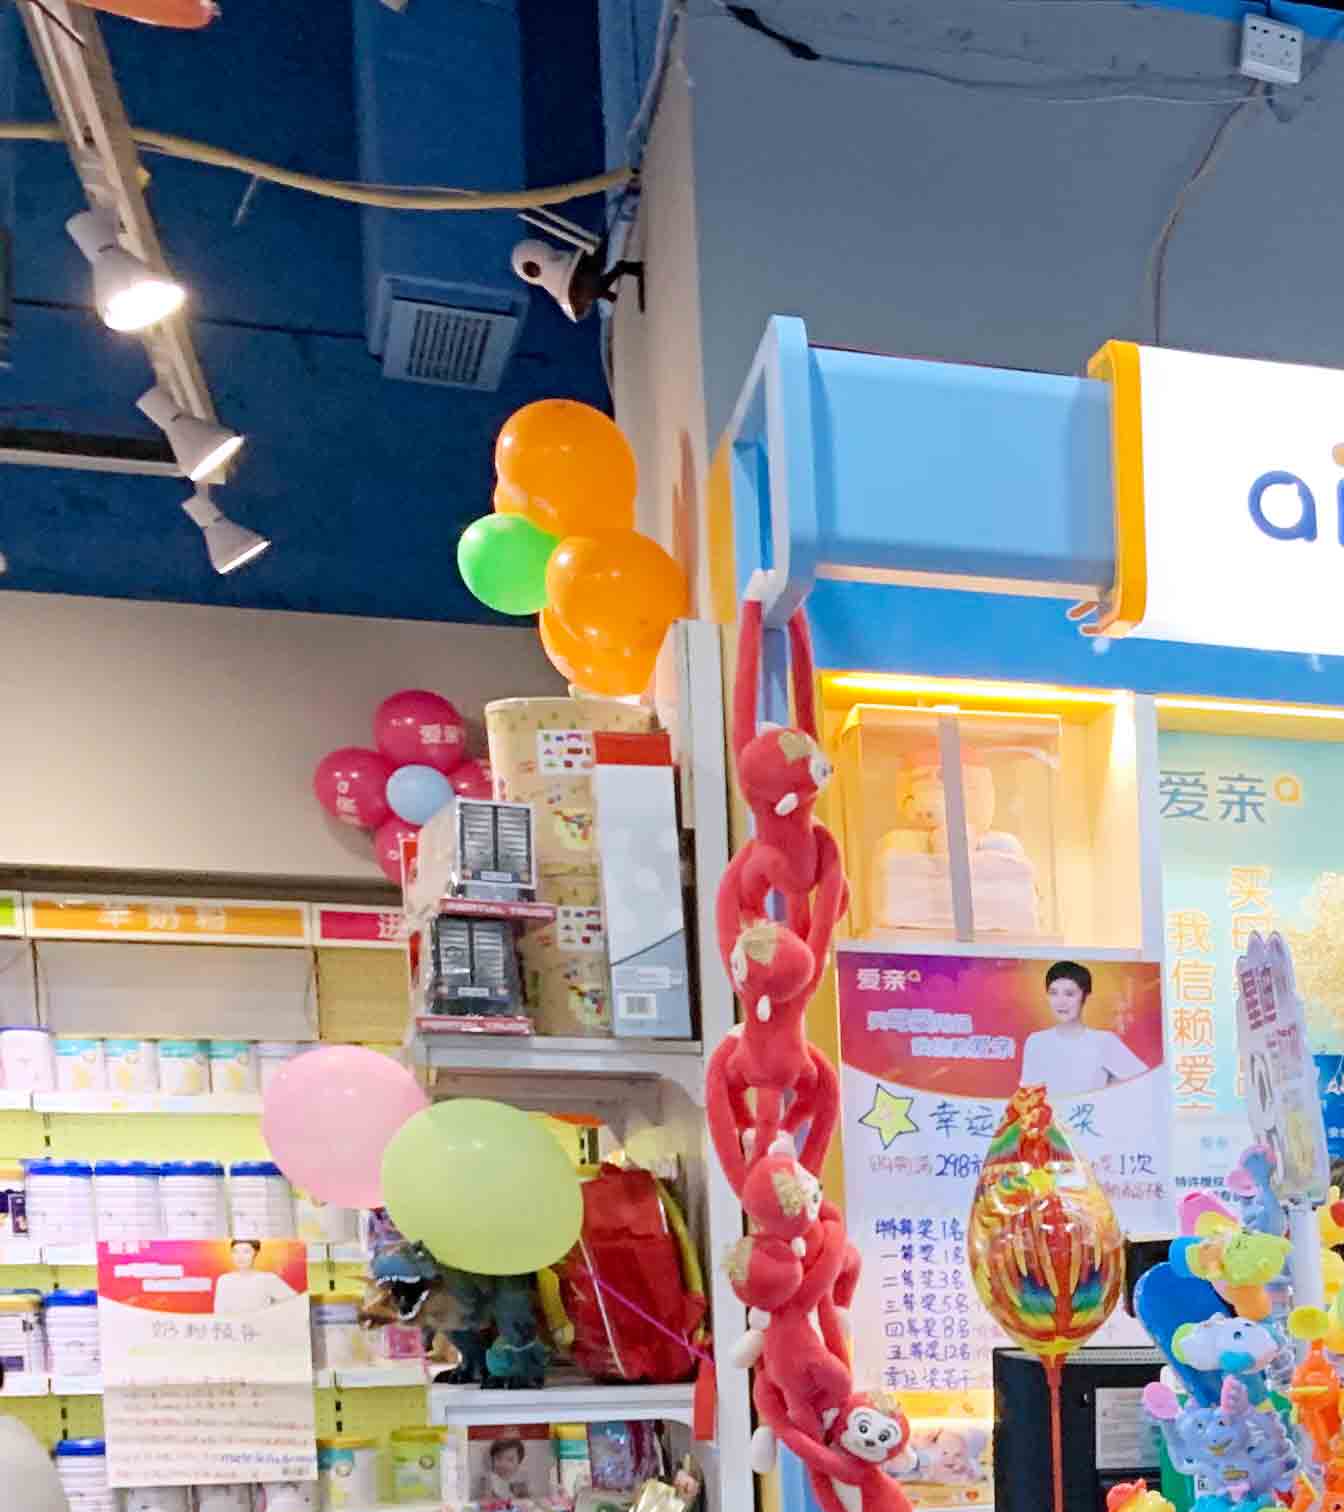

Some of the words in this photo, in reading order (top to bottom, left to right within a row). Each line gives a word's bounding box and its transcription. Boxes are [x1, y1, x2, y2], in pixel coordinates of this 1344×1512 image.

[1160, 770, 1267, 824] 爱亲
[856, 967, 907, 992] 爱亲
[1168, 909, 1217, 1112] 我信赖爱
